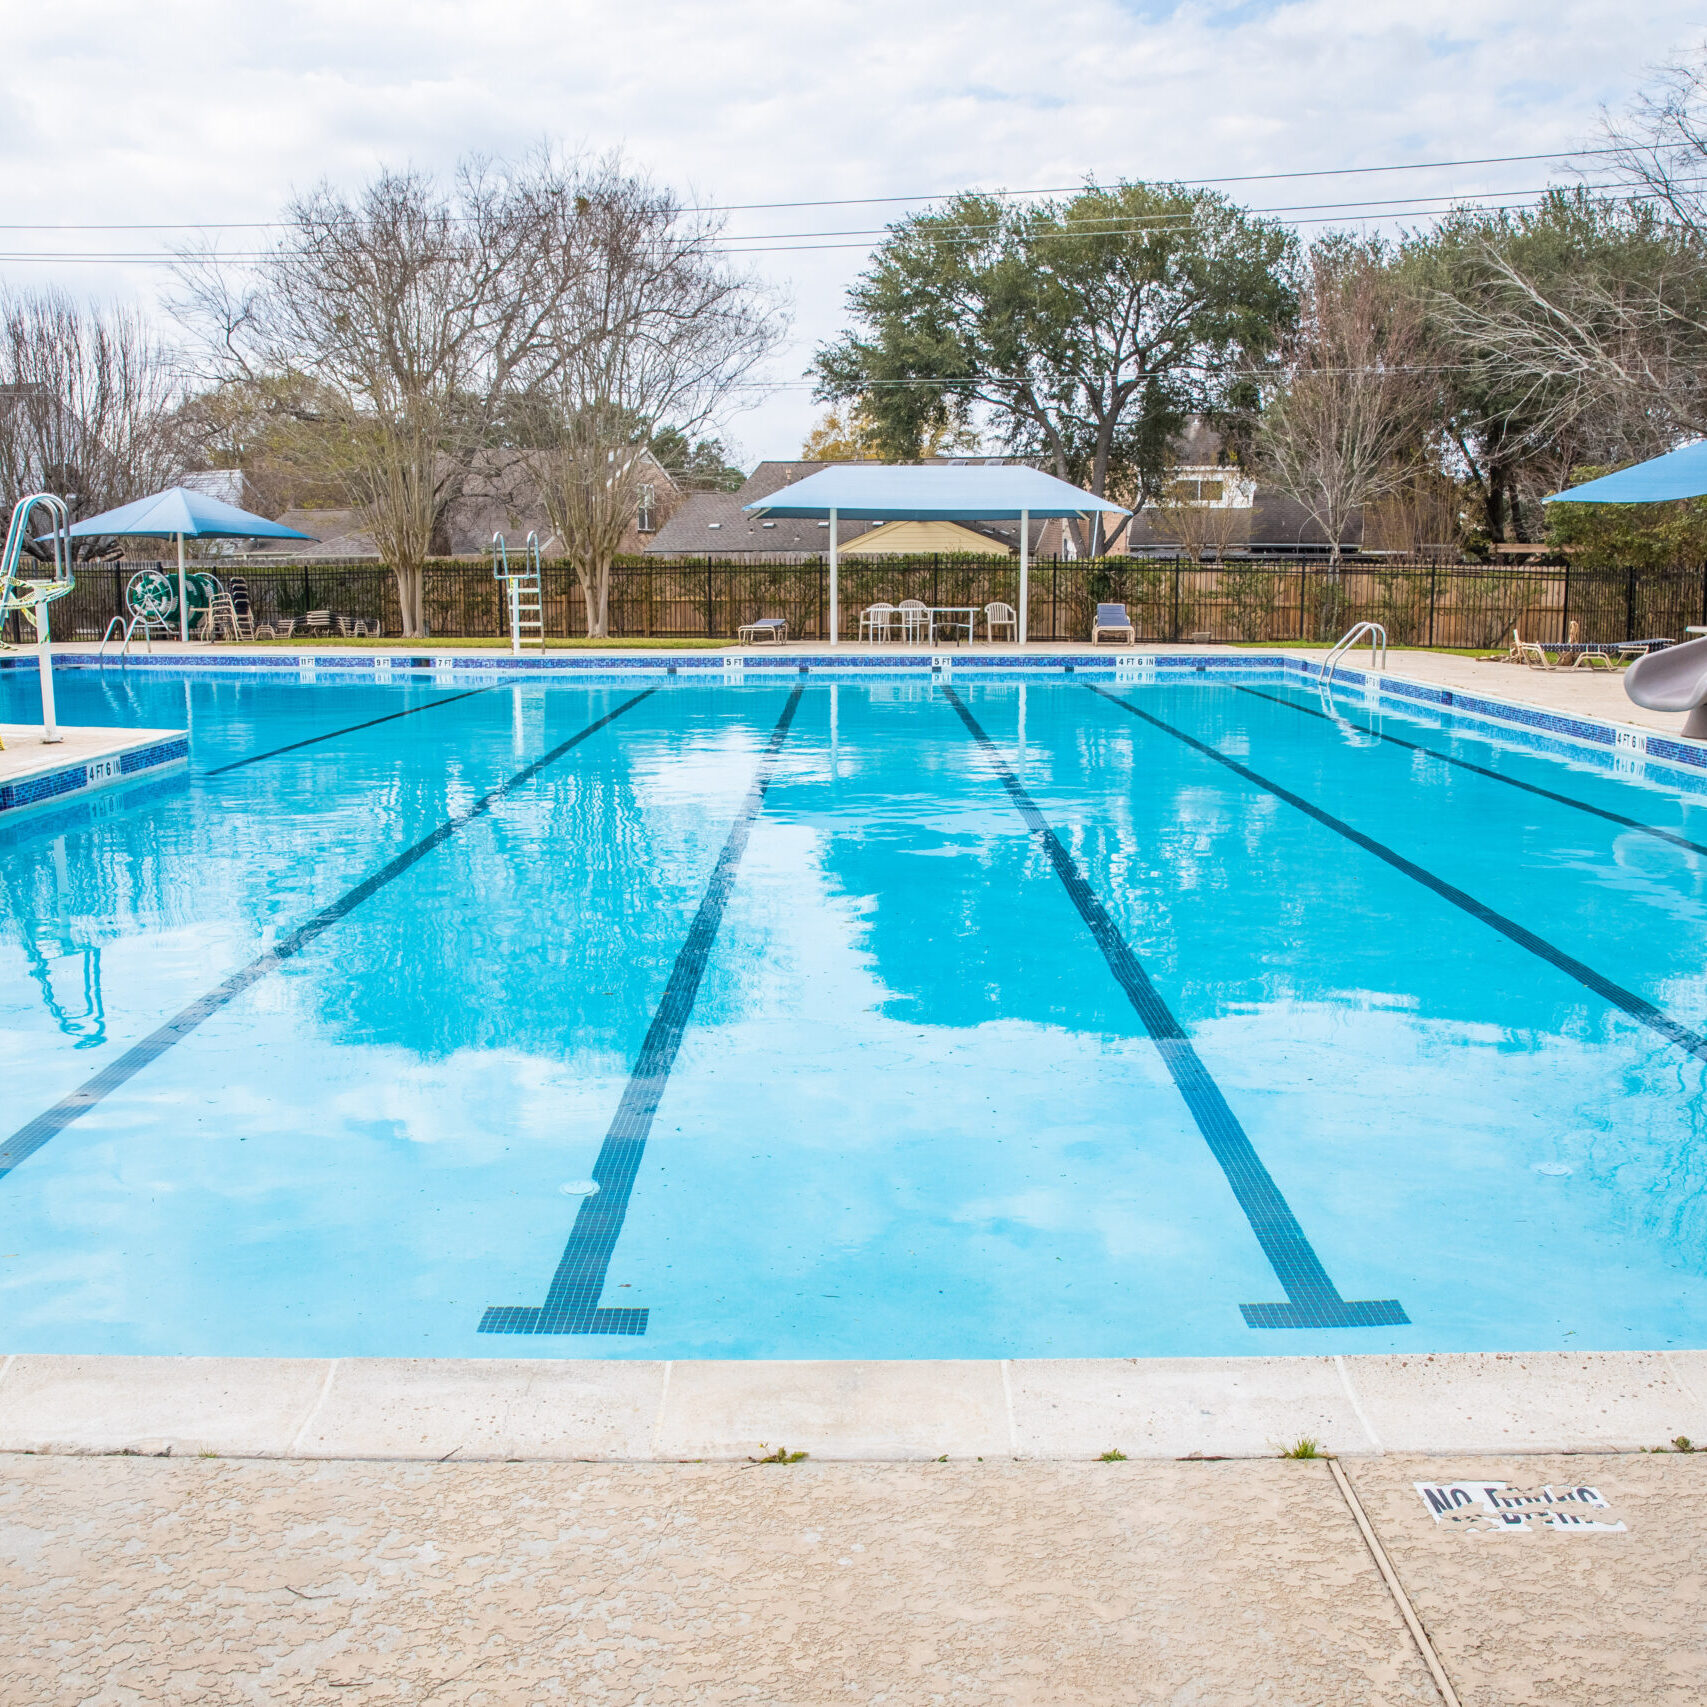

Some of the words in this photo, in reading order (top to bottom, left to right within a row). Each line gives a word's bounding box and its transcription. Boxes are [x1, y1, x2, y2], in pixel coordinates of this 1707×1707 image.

[733, 658, 742, 666] FT
[942, 657, 950, 666] FT
[1126, 658, 1134, 666] FT
[1146, 658, 1154, 666] IN
[89, 766, 94, 781] 4
[96, 763, 103, 779] FT
[106, 762, 111, 776] 6
[113, 760, 120, 774] IN
[1424, 1488, 1473, 1514] NO
